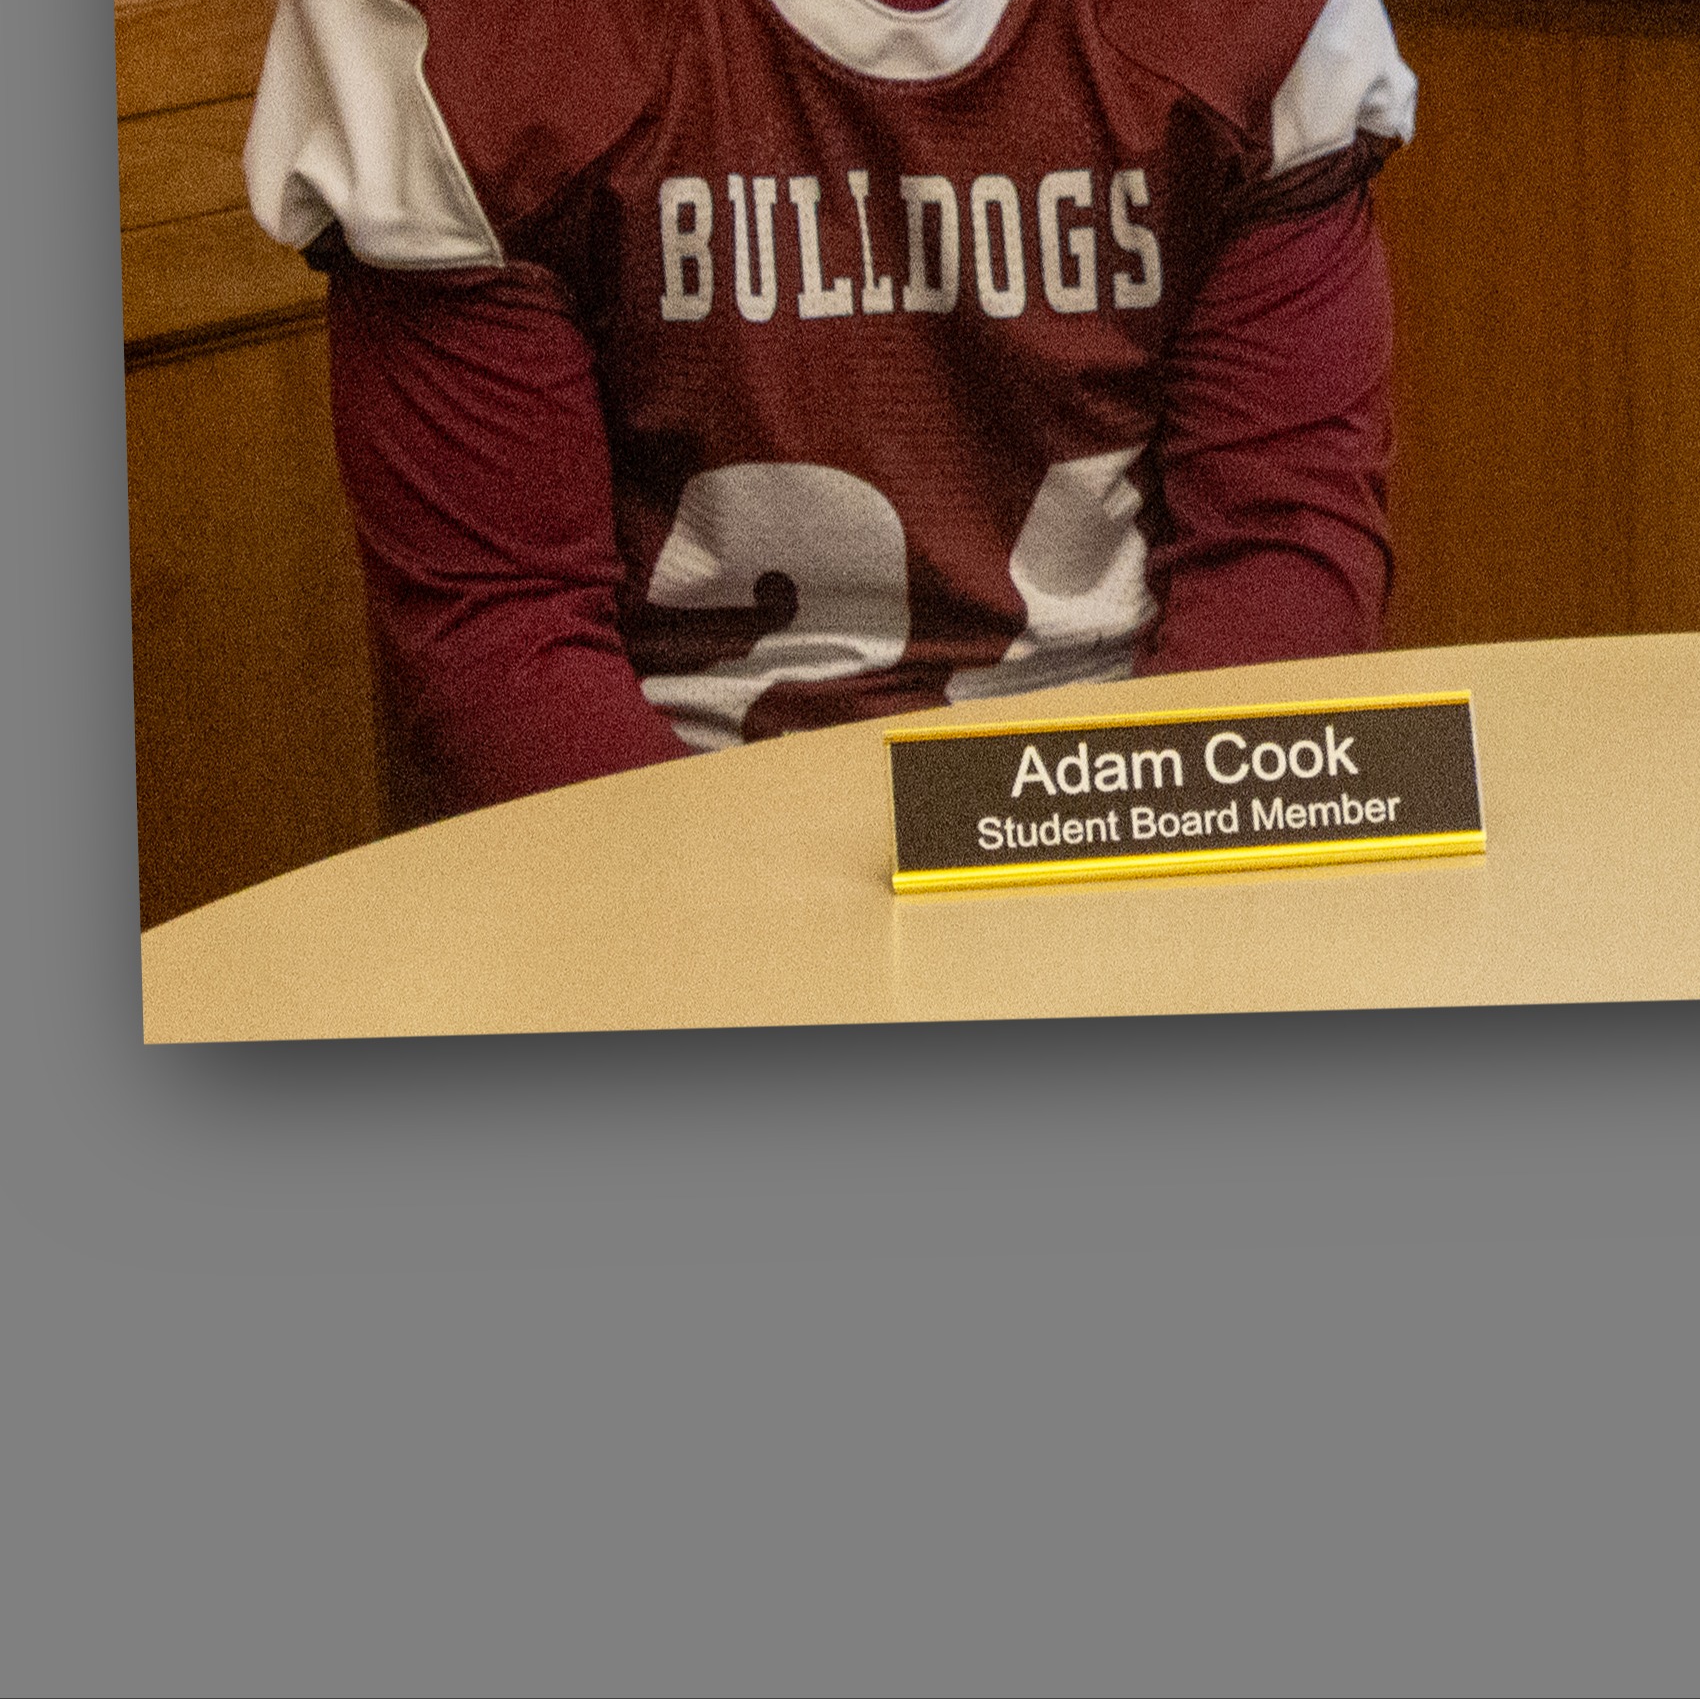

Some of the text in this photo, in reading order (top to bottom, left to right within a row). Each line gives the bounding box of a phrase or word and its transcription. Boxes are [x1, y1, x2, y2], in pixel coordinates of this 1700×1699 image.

[659, 167, 1164, 324] BULLDOGS
[1011, 725, 1359, 798] Adam Cook
[977, 793, 1402, 851] Student Board Member
